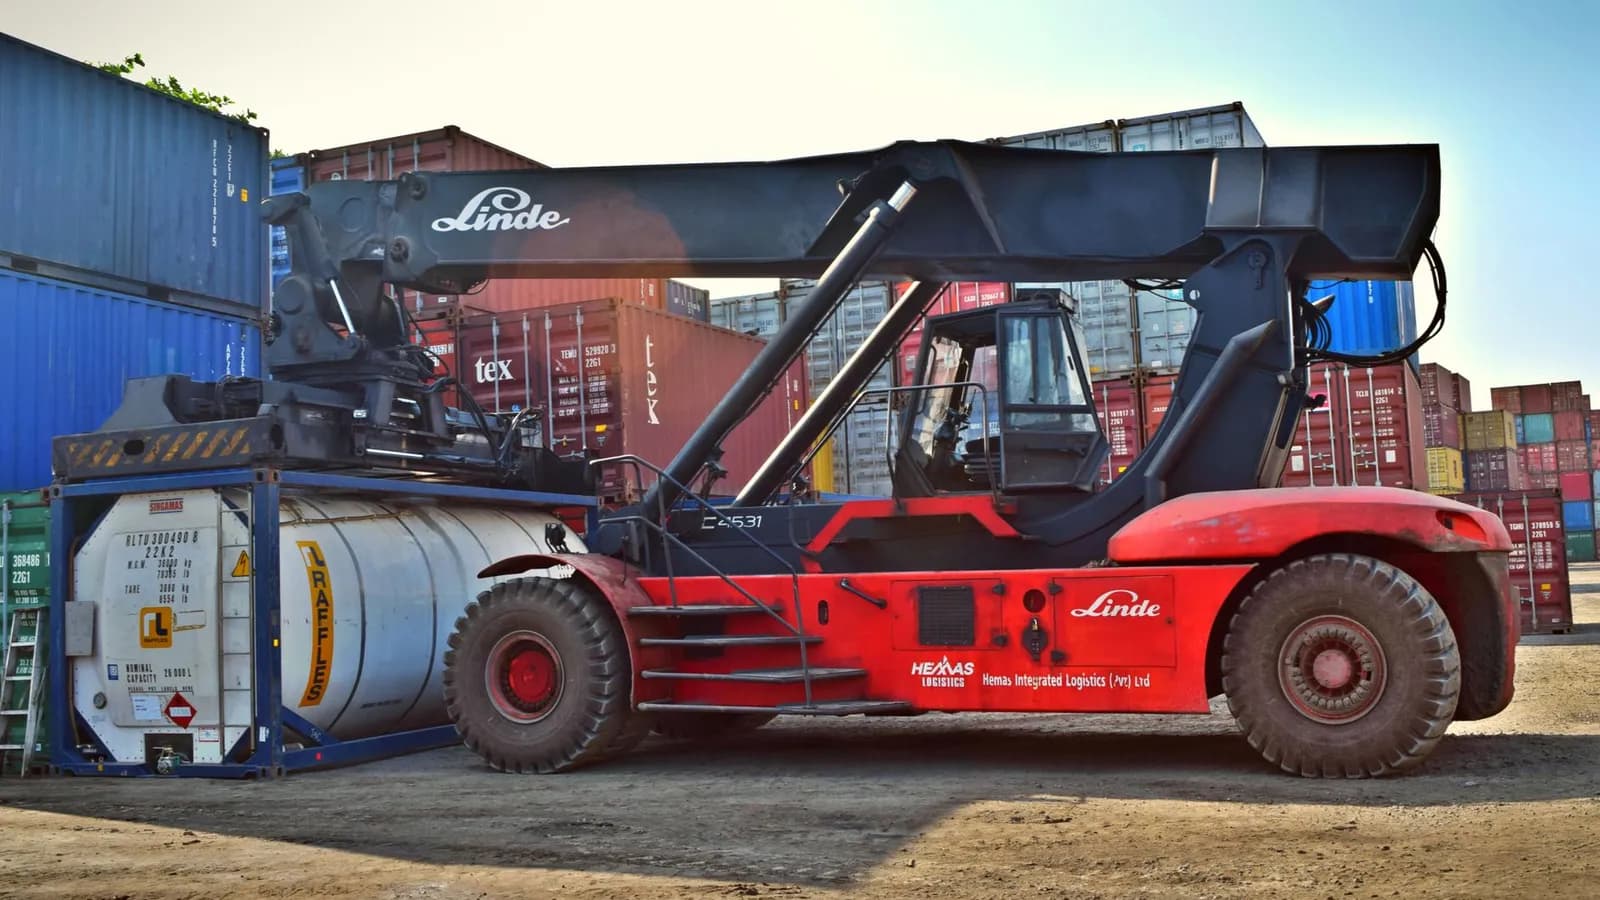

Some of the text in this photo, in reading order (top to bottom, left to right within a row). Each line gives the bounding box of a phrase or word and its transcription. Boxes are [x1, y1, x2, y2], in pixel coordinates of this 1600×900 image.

[431, 186, 570, 232] Linde
[475, 356, 514, 383] tex
[645, 334, 660, 424] tex
[13, 554, 40, 567] 368486
[13, 571, 31, 583] 22G1
[1070, 589, 1160, 617] Linde
[307, 570, 329, 701] RAFFLES
[126, 663, 153, 673] NOMINAL
[911, 655, 975, 676] HEMAS
[127, 674, 157, 683] CAPACITY
[922, 677, 965, 688] LOGISTICS
[982, 673, 1012, 686] Hemas
[1015, 673, 1062, 690] Integrated
[1066, 673, 1106, 690] Logistics
